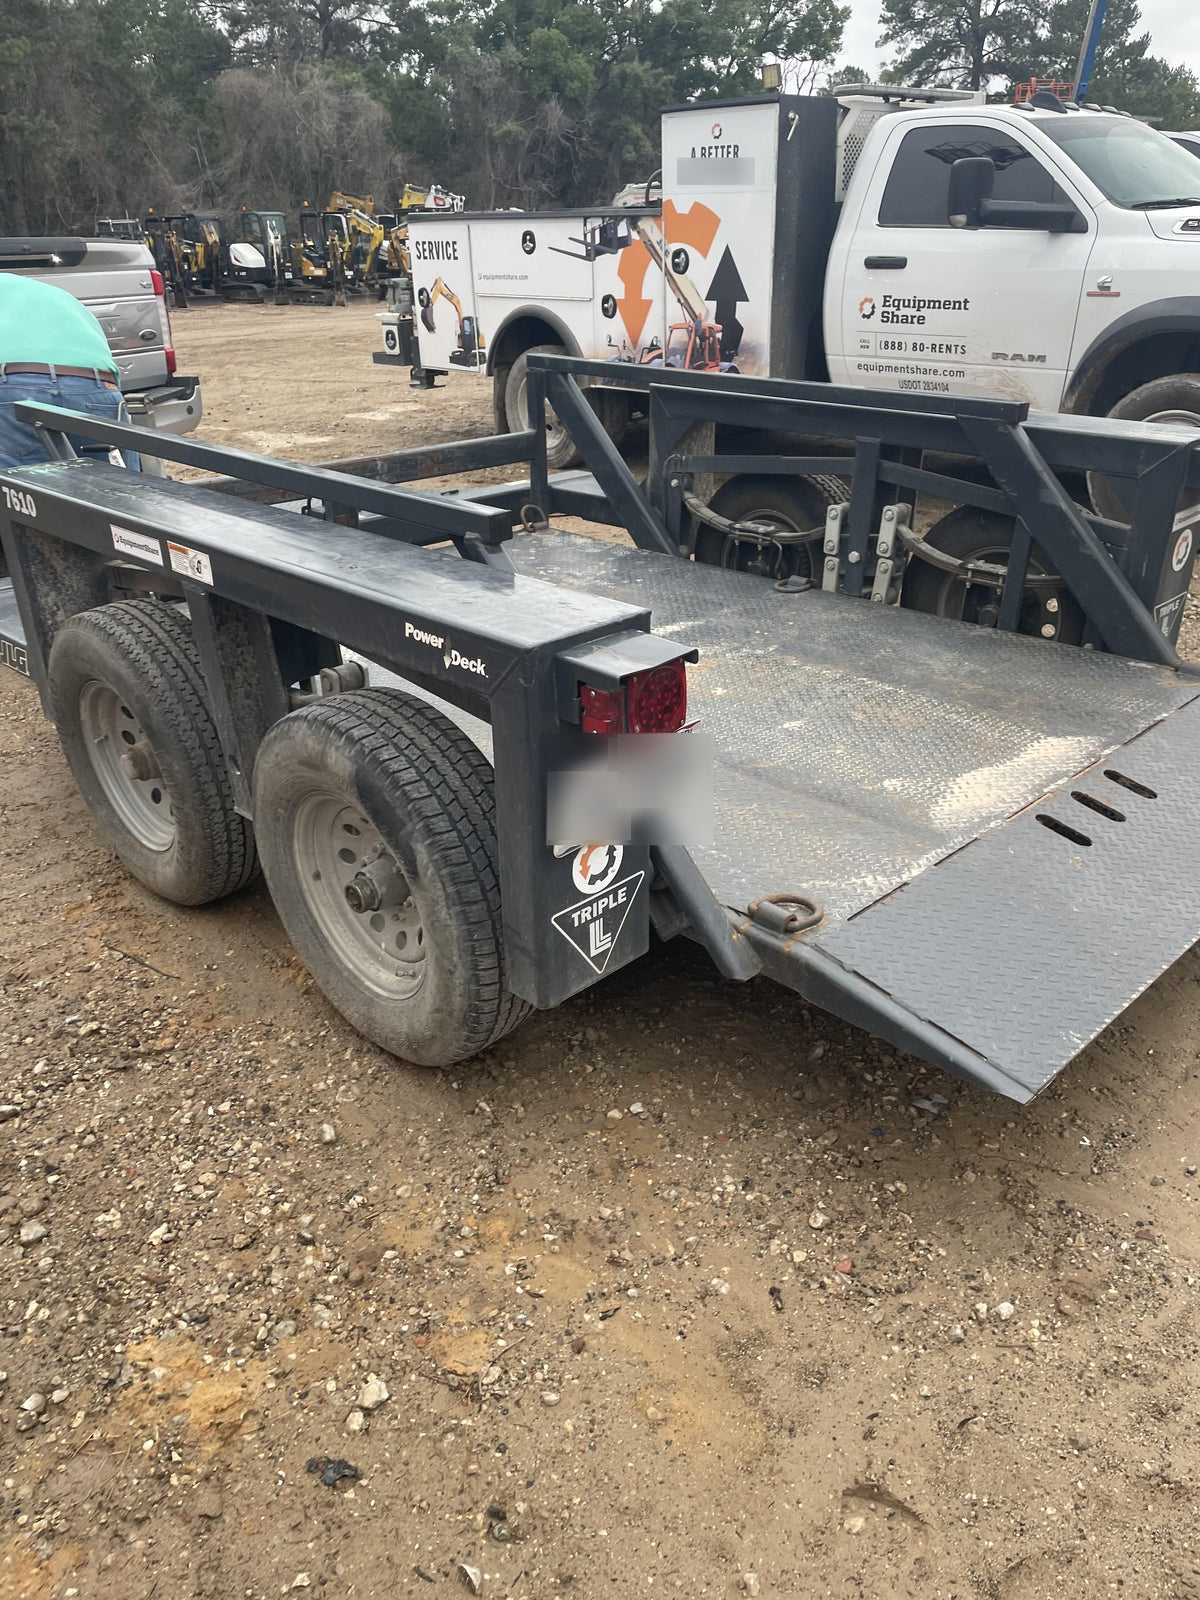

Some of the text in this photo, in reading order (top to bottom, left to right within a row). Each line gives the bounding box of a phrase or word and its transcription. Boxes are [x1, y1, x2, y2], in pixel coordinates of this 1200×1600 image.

[415, 240, 459, 261] SERVICE
[881, 295, 970, 312] Equipment
[880, 310, 926, 325] Share
[879, 340, 967, 355] (888) 80-RENTS
[991, 352, 1046, 362] RAM
[857, 362, 965, 378] equipmentshare.com
[898, 379, 950, 392] USDOT 2834104
[1, 485, 37, 518] 7610
[119, 535, 160, 556] EquipmentShare
[405, 622, 486, 676] Power Deck
[571, 886, 627, 928] TRIPLE
